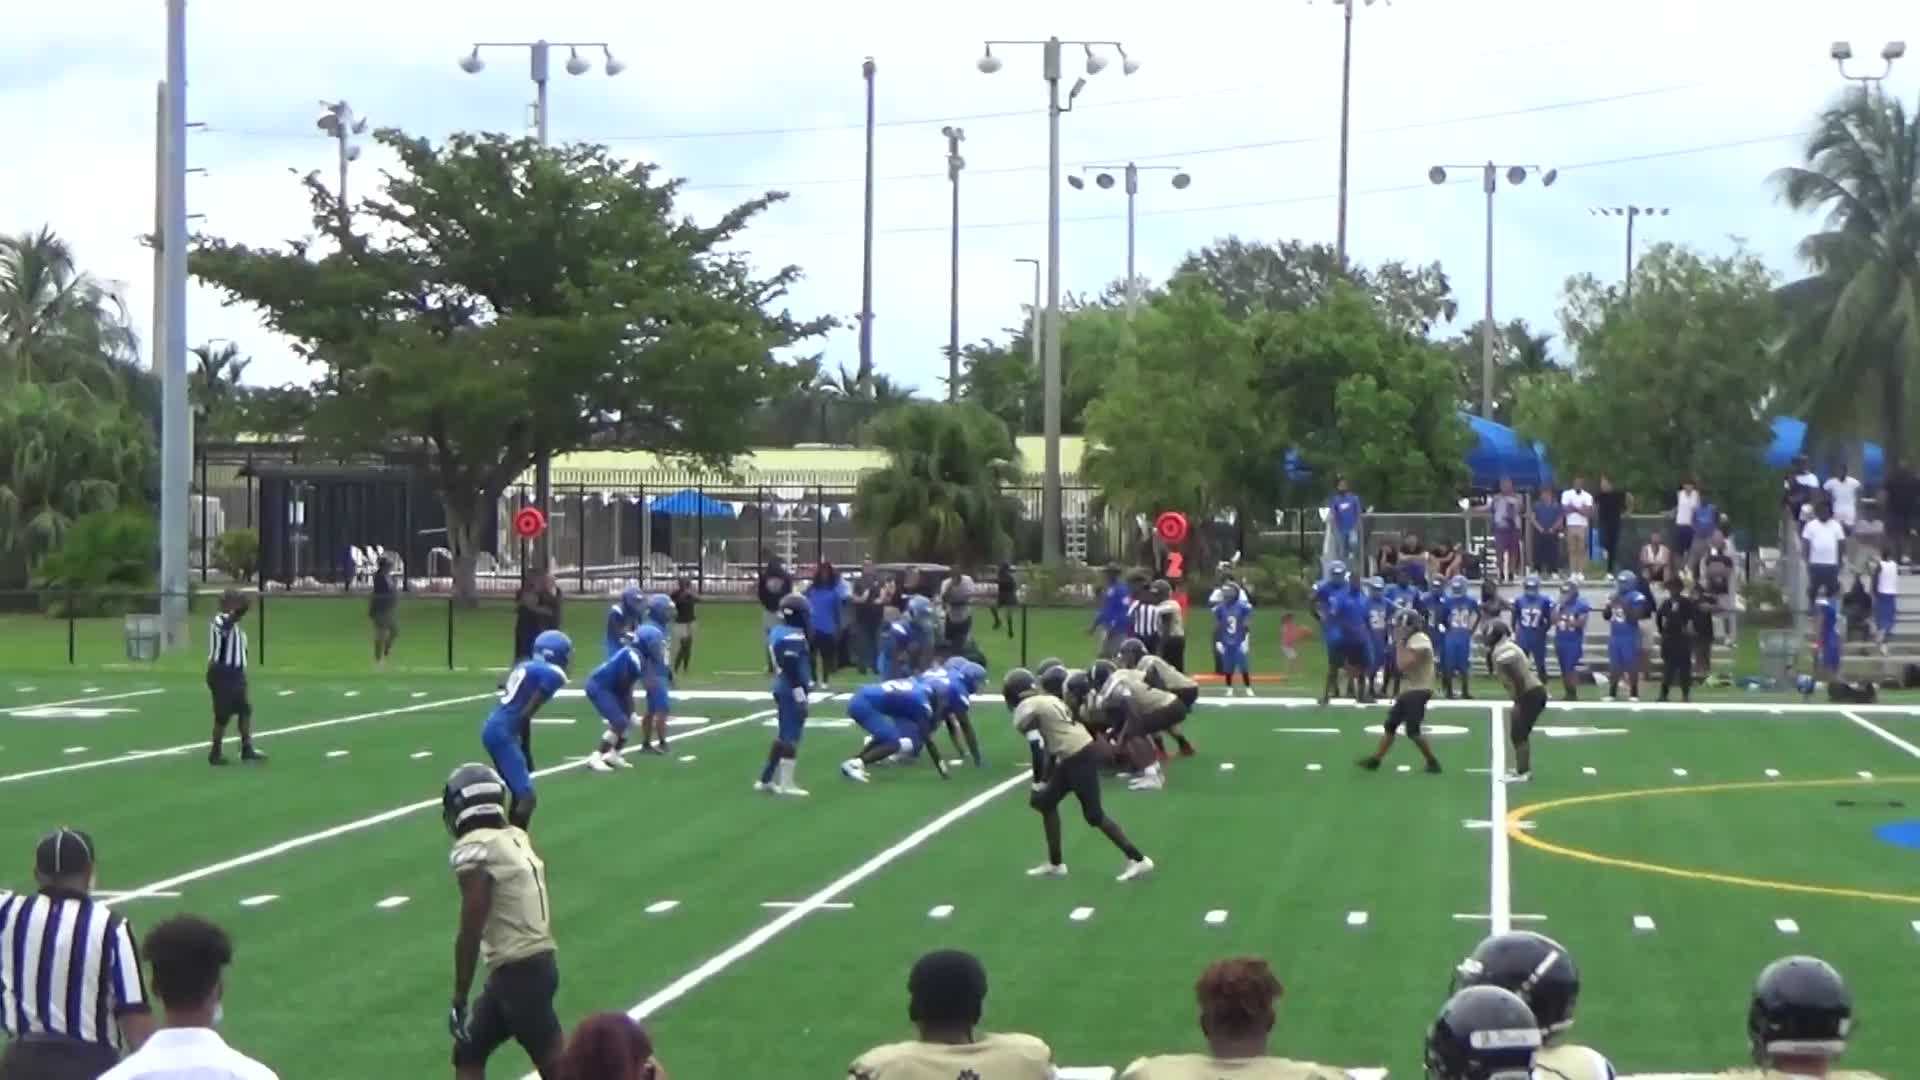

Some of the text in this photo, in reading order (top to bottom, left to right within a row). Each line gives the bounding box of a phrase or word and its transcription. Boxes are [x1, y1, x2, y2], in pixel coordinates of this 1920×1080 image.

[1167, 552, 1184, 578] 2
[1226, 616, 1237, 634] 3
[1520, 607, 1542, 628] 57
